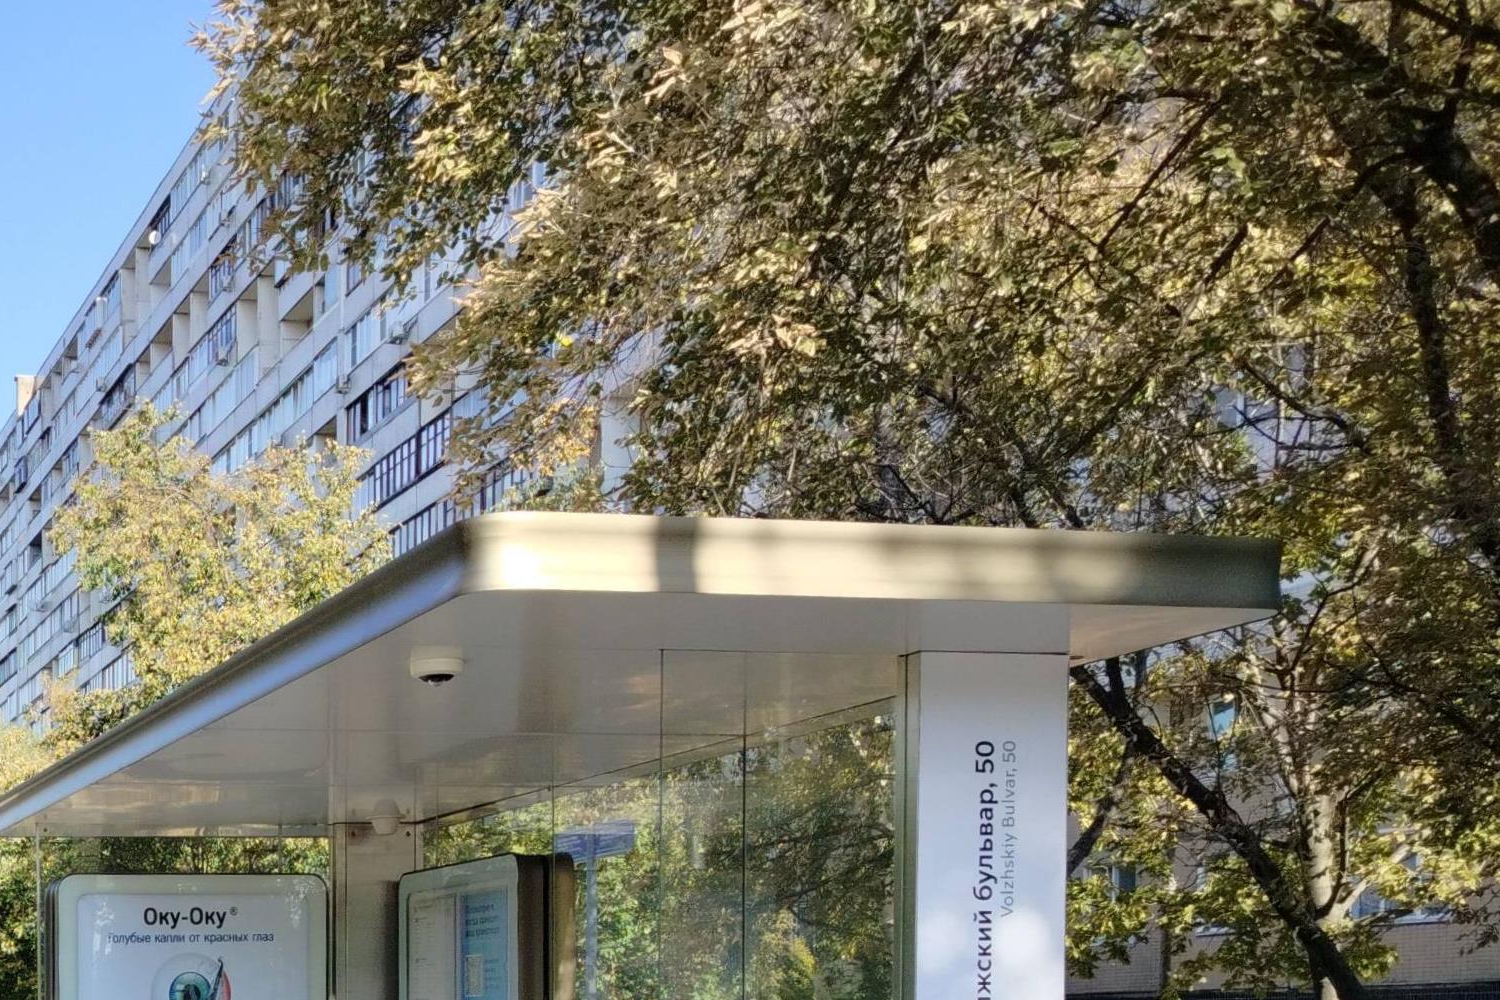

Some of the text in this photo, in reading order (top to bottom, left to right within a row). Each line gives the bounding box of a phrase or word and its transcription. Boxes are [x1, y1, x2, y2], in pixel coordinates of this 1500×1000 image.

[975, 740, 995, 774] 50
[973, 782, 999, 901] бульвар,
[1000, 740, 1018, 918] Volzhskiy Bulvar, 50
[154, 933, 186, 944] капли
[188, 933, 200, 943] от
[203, 932, 249, 946] красных
[252, 932, 275, 943] глаз
